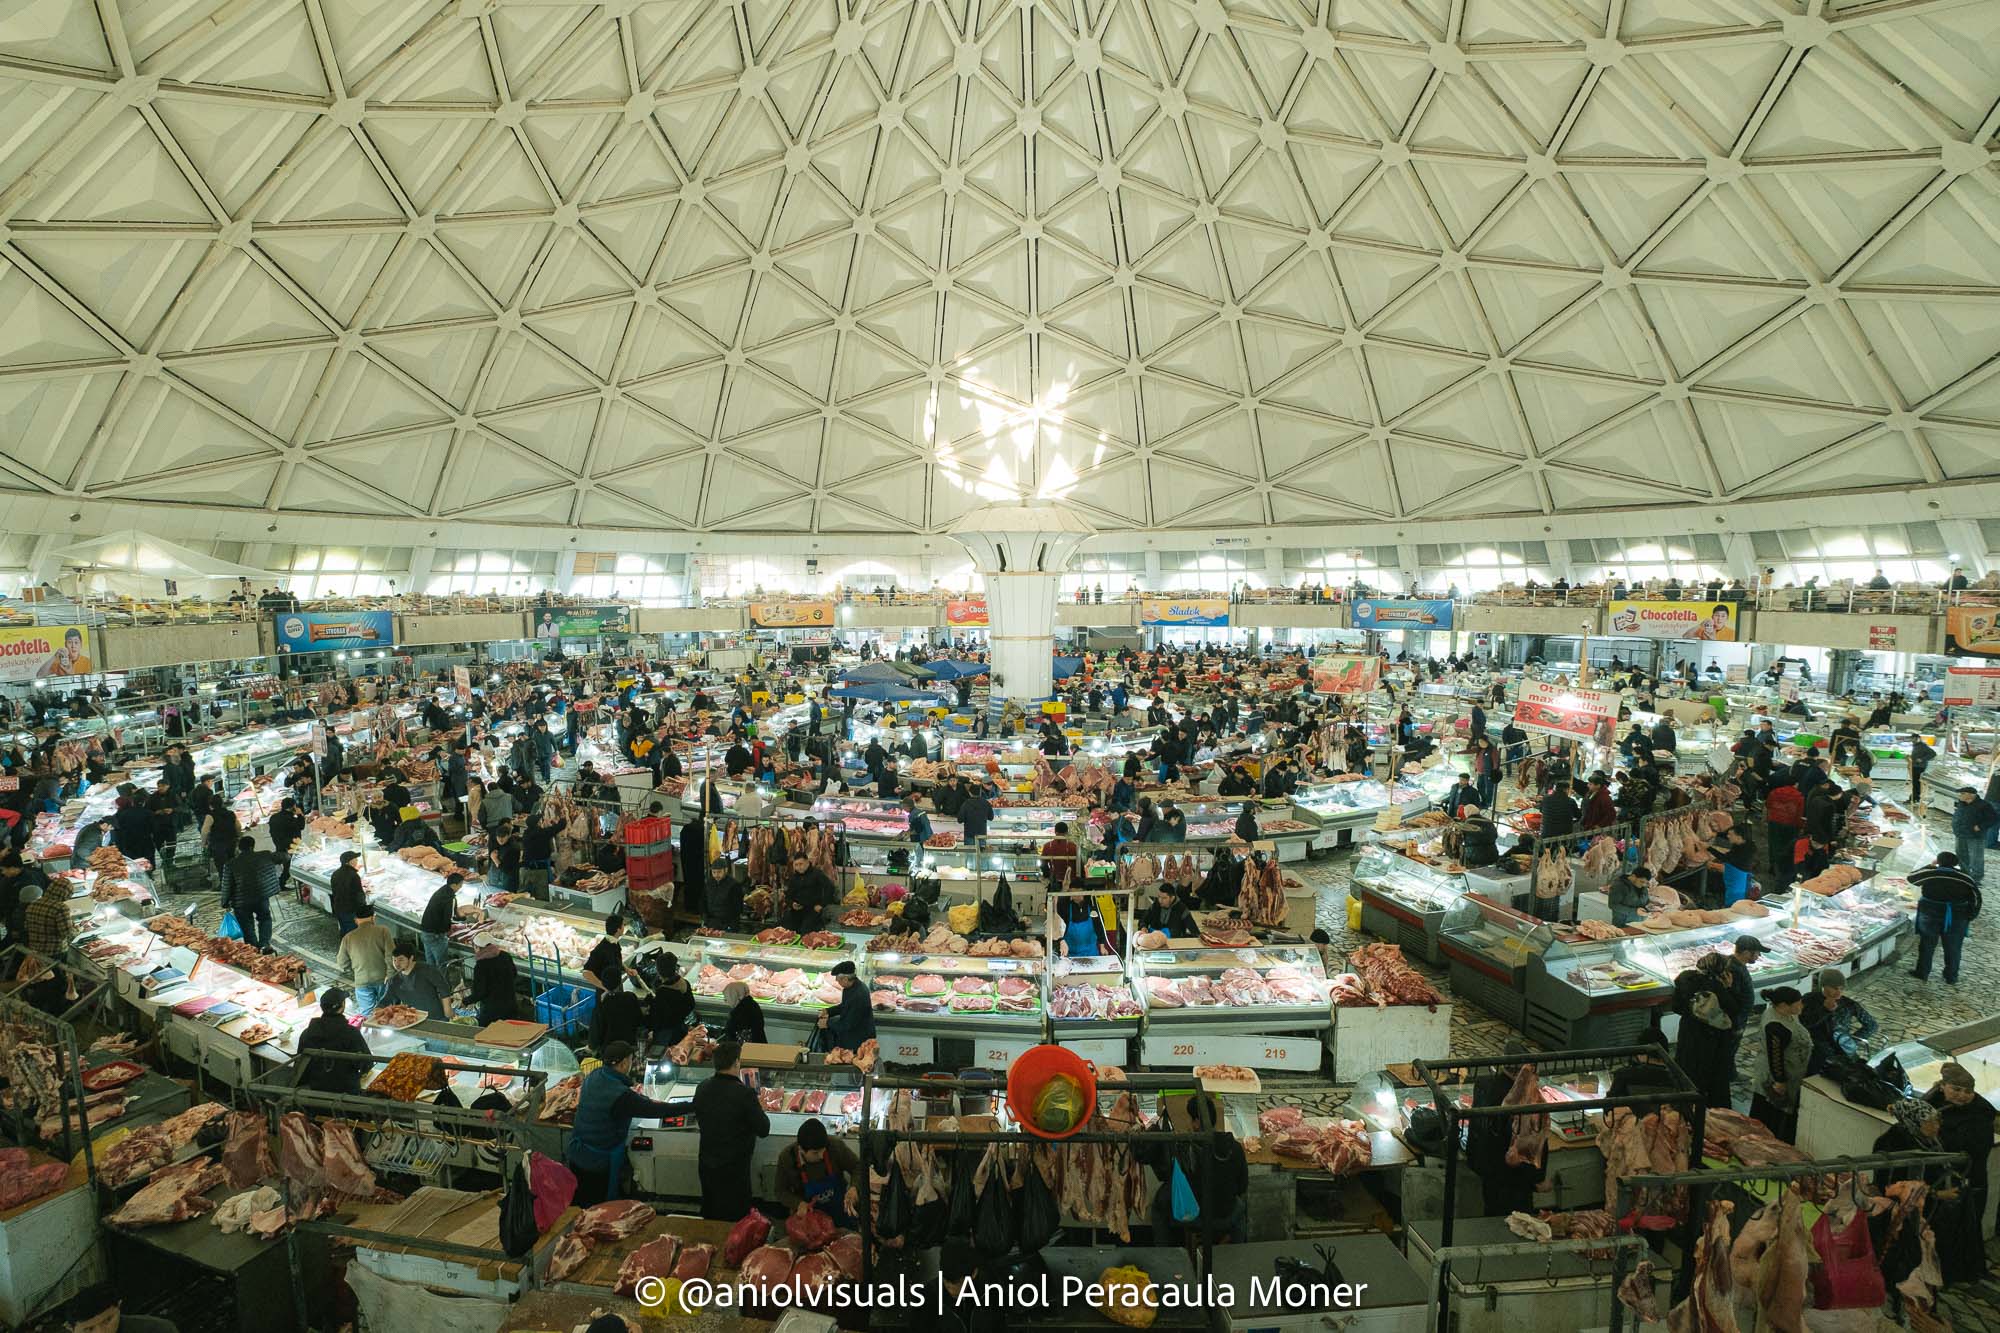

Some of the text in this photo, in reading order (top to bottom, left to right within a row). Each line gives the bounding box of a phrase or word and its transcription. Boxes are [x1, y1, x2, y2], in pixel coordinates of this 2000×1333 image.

[1640, 609, 1698, 622] Chocotella
[1539, 684, 1553, 693] Ot
[898, 1046, 919, 1057] 222
[988, 1049, 1008, 1061] 221
[1173, 1045, 1194, 1055] 220
[1265, 1048, 1286, 1059] 219
